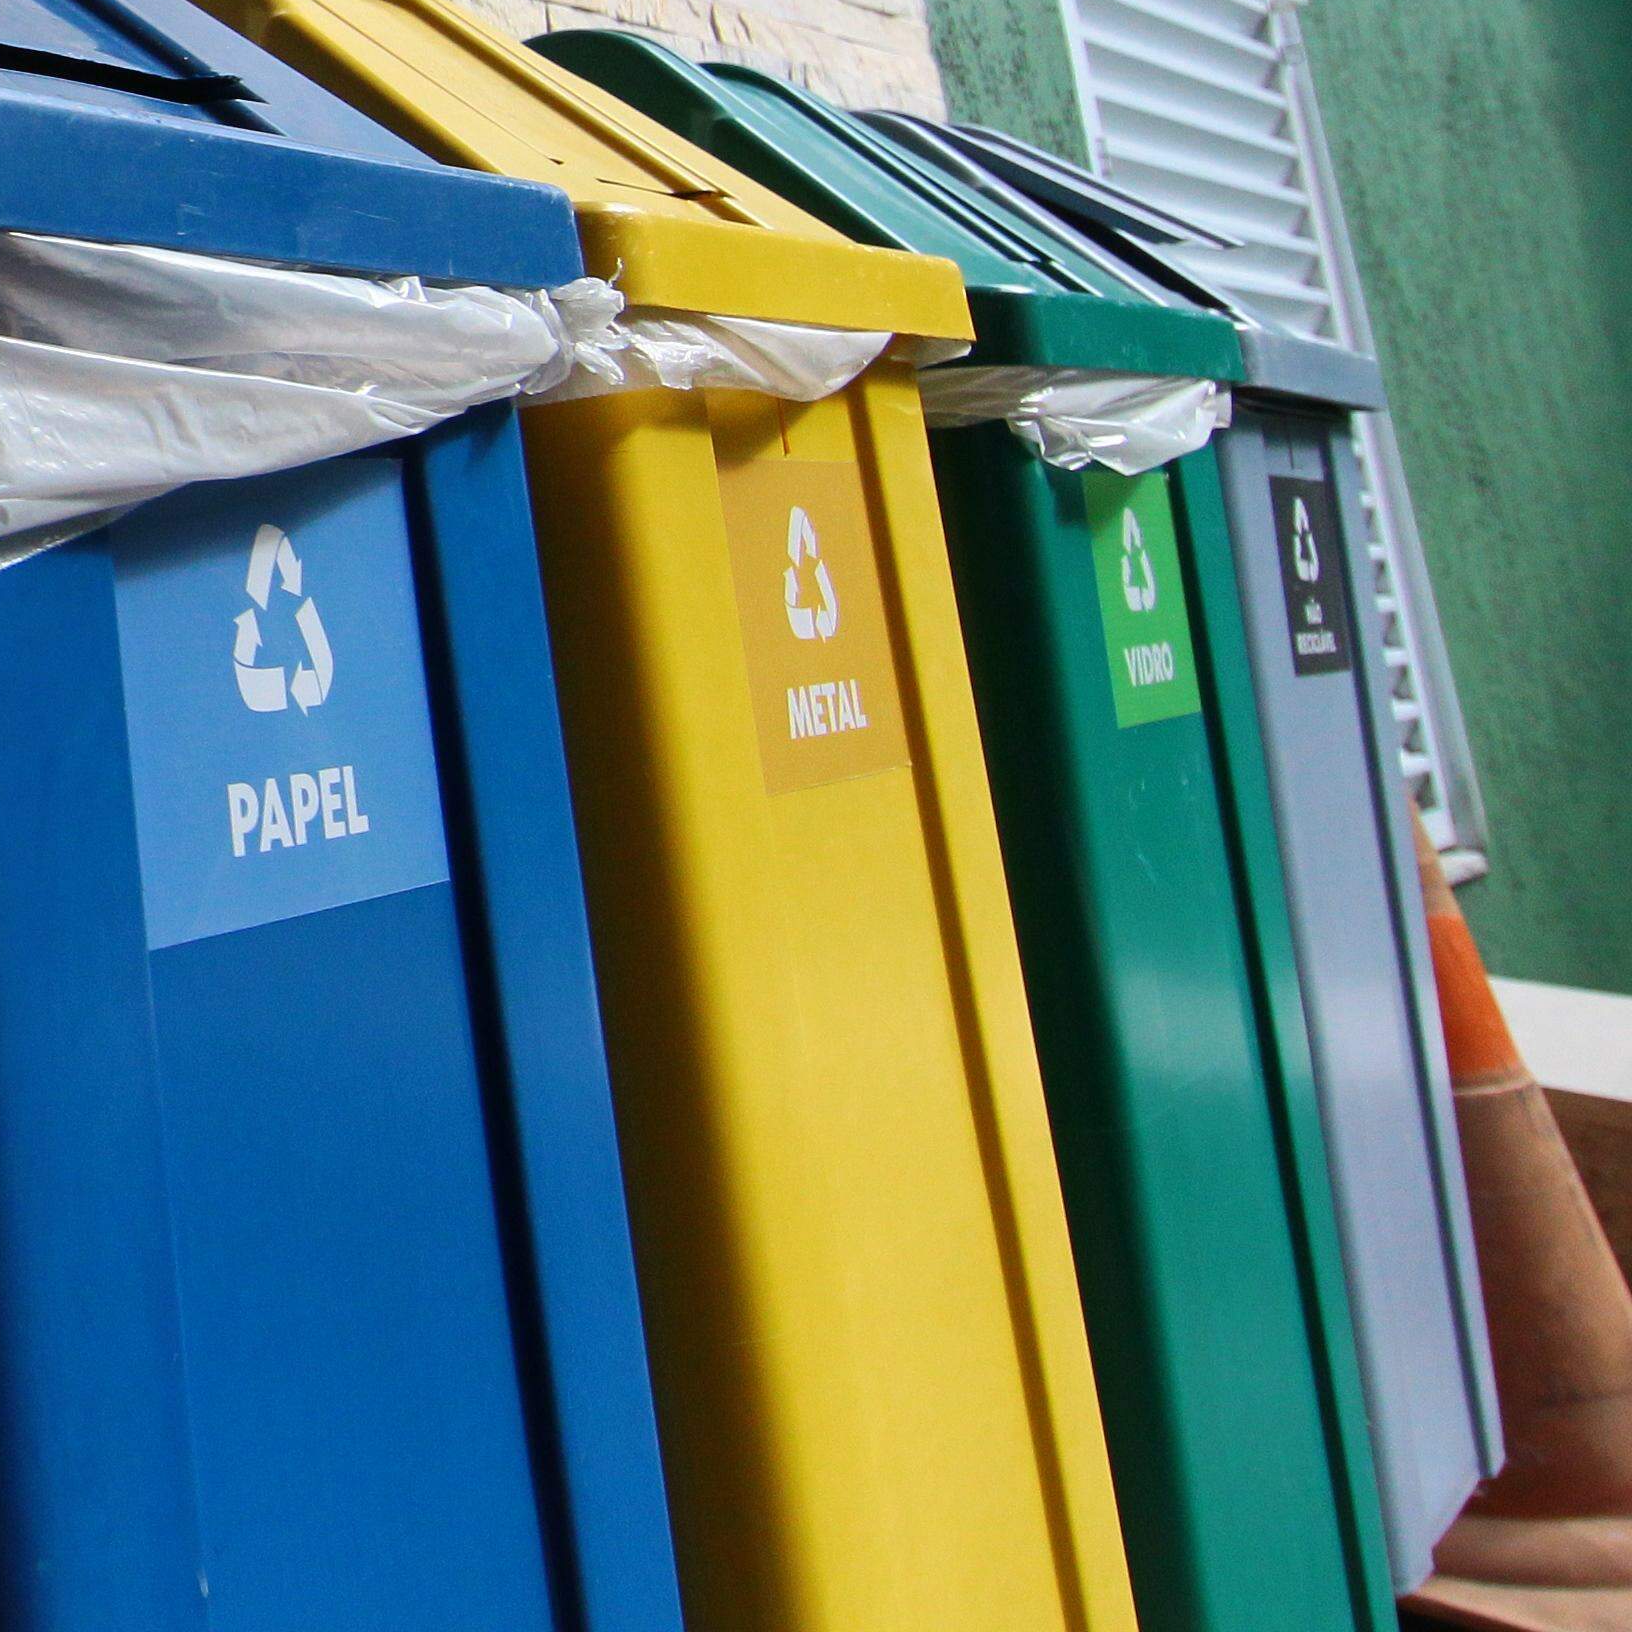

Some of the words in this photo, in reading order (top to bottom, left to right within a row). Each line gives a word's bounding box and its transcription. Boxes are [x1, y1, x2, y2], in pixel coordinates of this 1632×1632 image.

[1123, 641, 1174, 688] VIDRO
[786, 678, 869, 741] METAL
[226, 765, 370, 858] PAPEL
